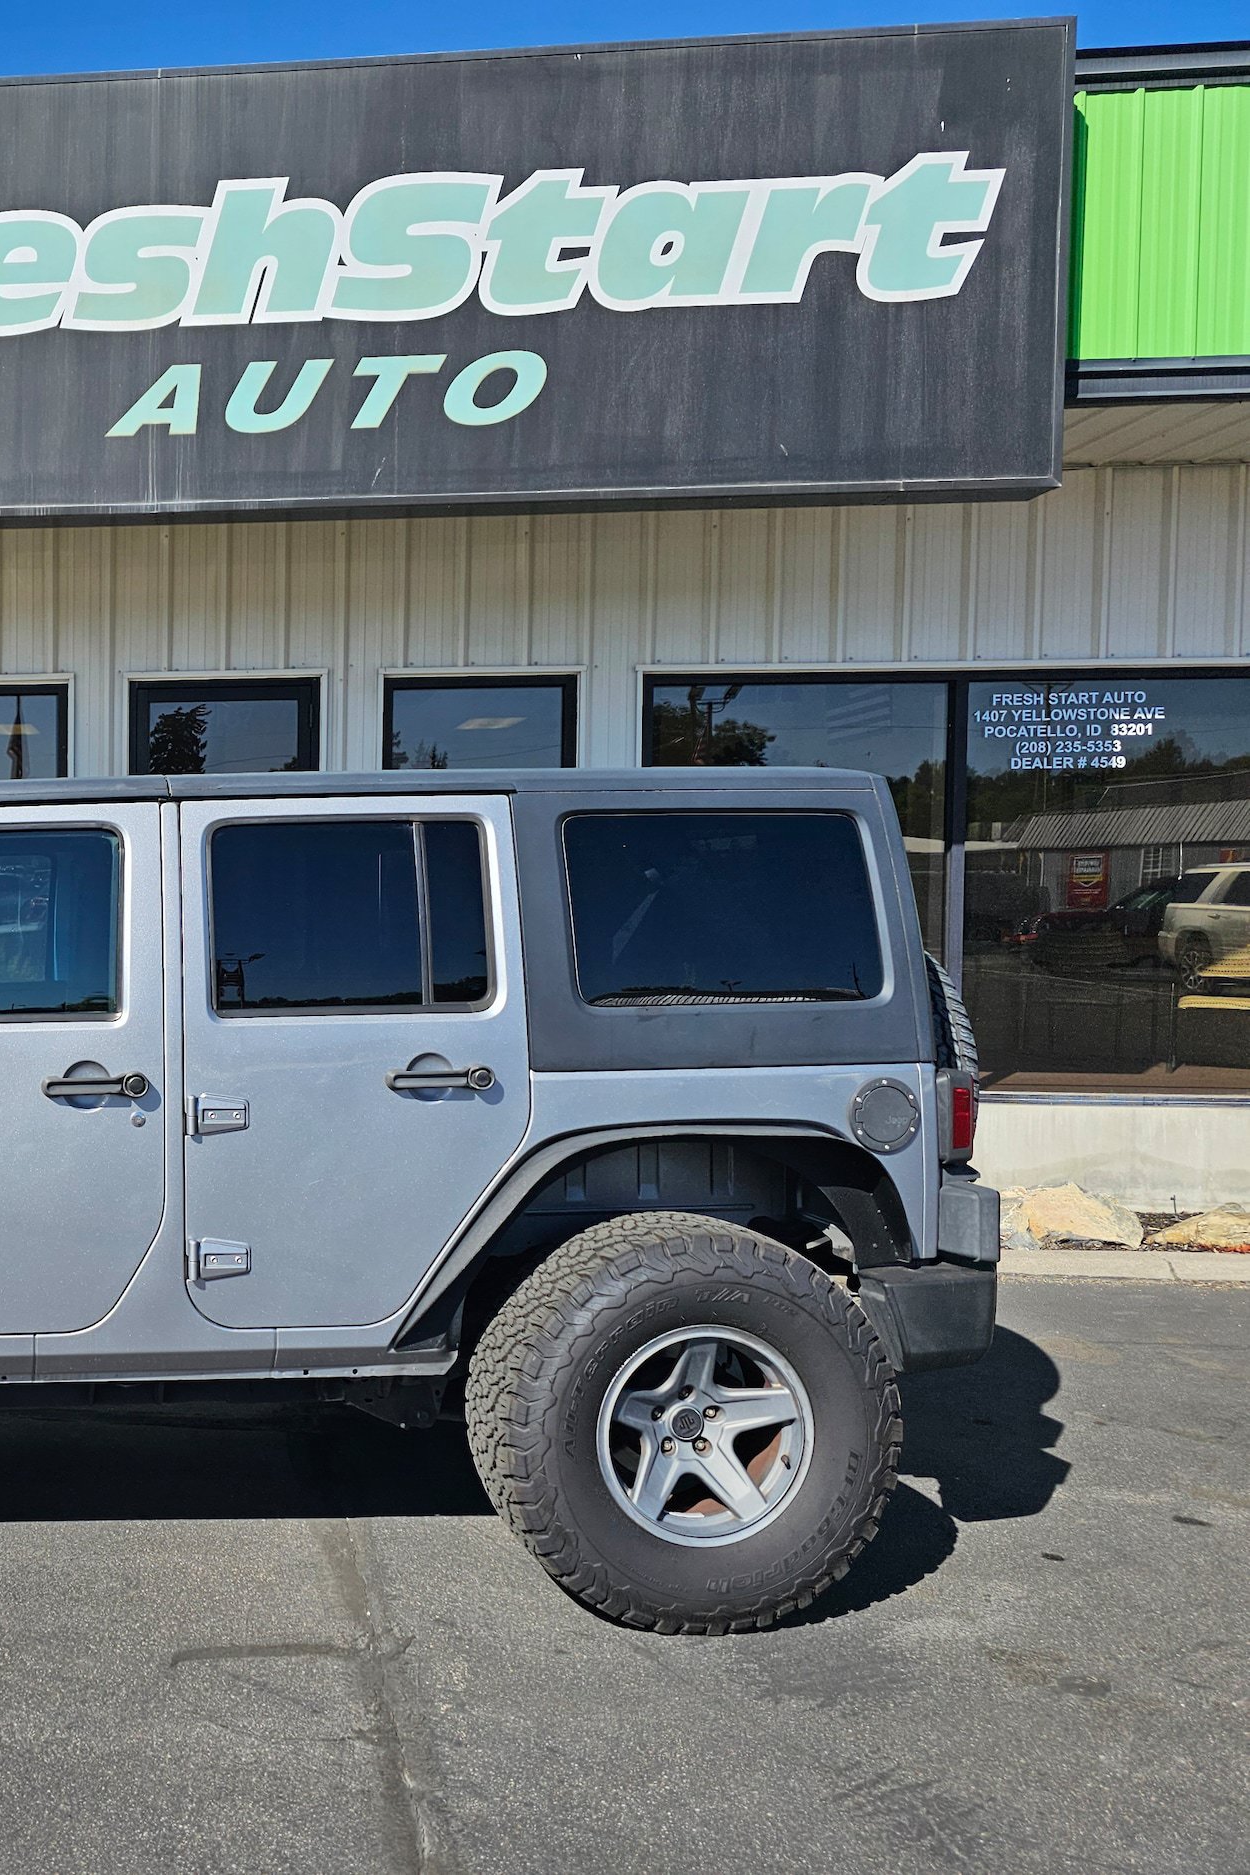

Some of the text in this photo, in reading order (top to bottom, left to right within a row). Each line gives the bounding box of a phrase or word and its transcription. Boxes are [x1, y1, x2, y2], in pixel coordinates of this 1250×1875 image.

[105, 350, 548, 438] AUTO
[992, 690, 1147, 706] FRESH START AUTO
[973, 706, 1165, 723] 1407 YELLOWSTONE AVE
[984, 722, 1153, 739] POCATELLO, ID 83201
[1015, 739, 1122, 756] (208) 235-5353
[1010, 755, 1126, 770] DEALER # 4549
[562, 1295, 680, 1460] All-Terrain
[707, 1449, 864, 1594] BFGoodrich
